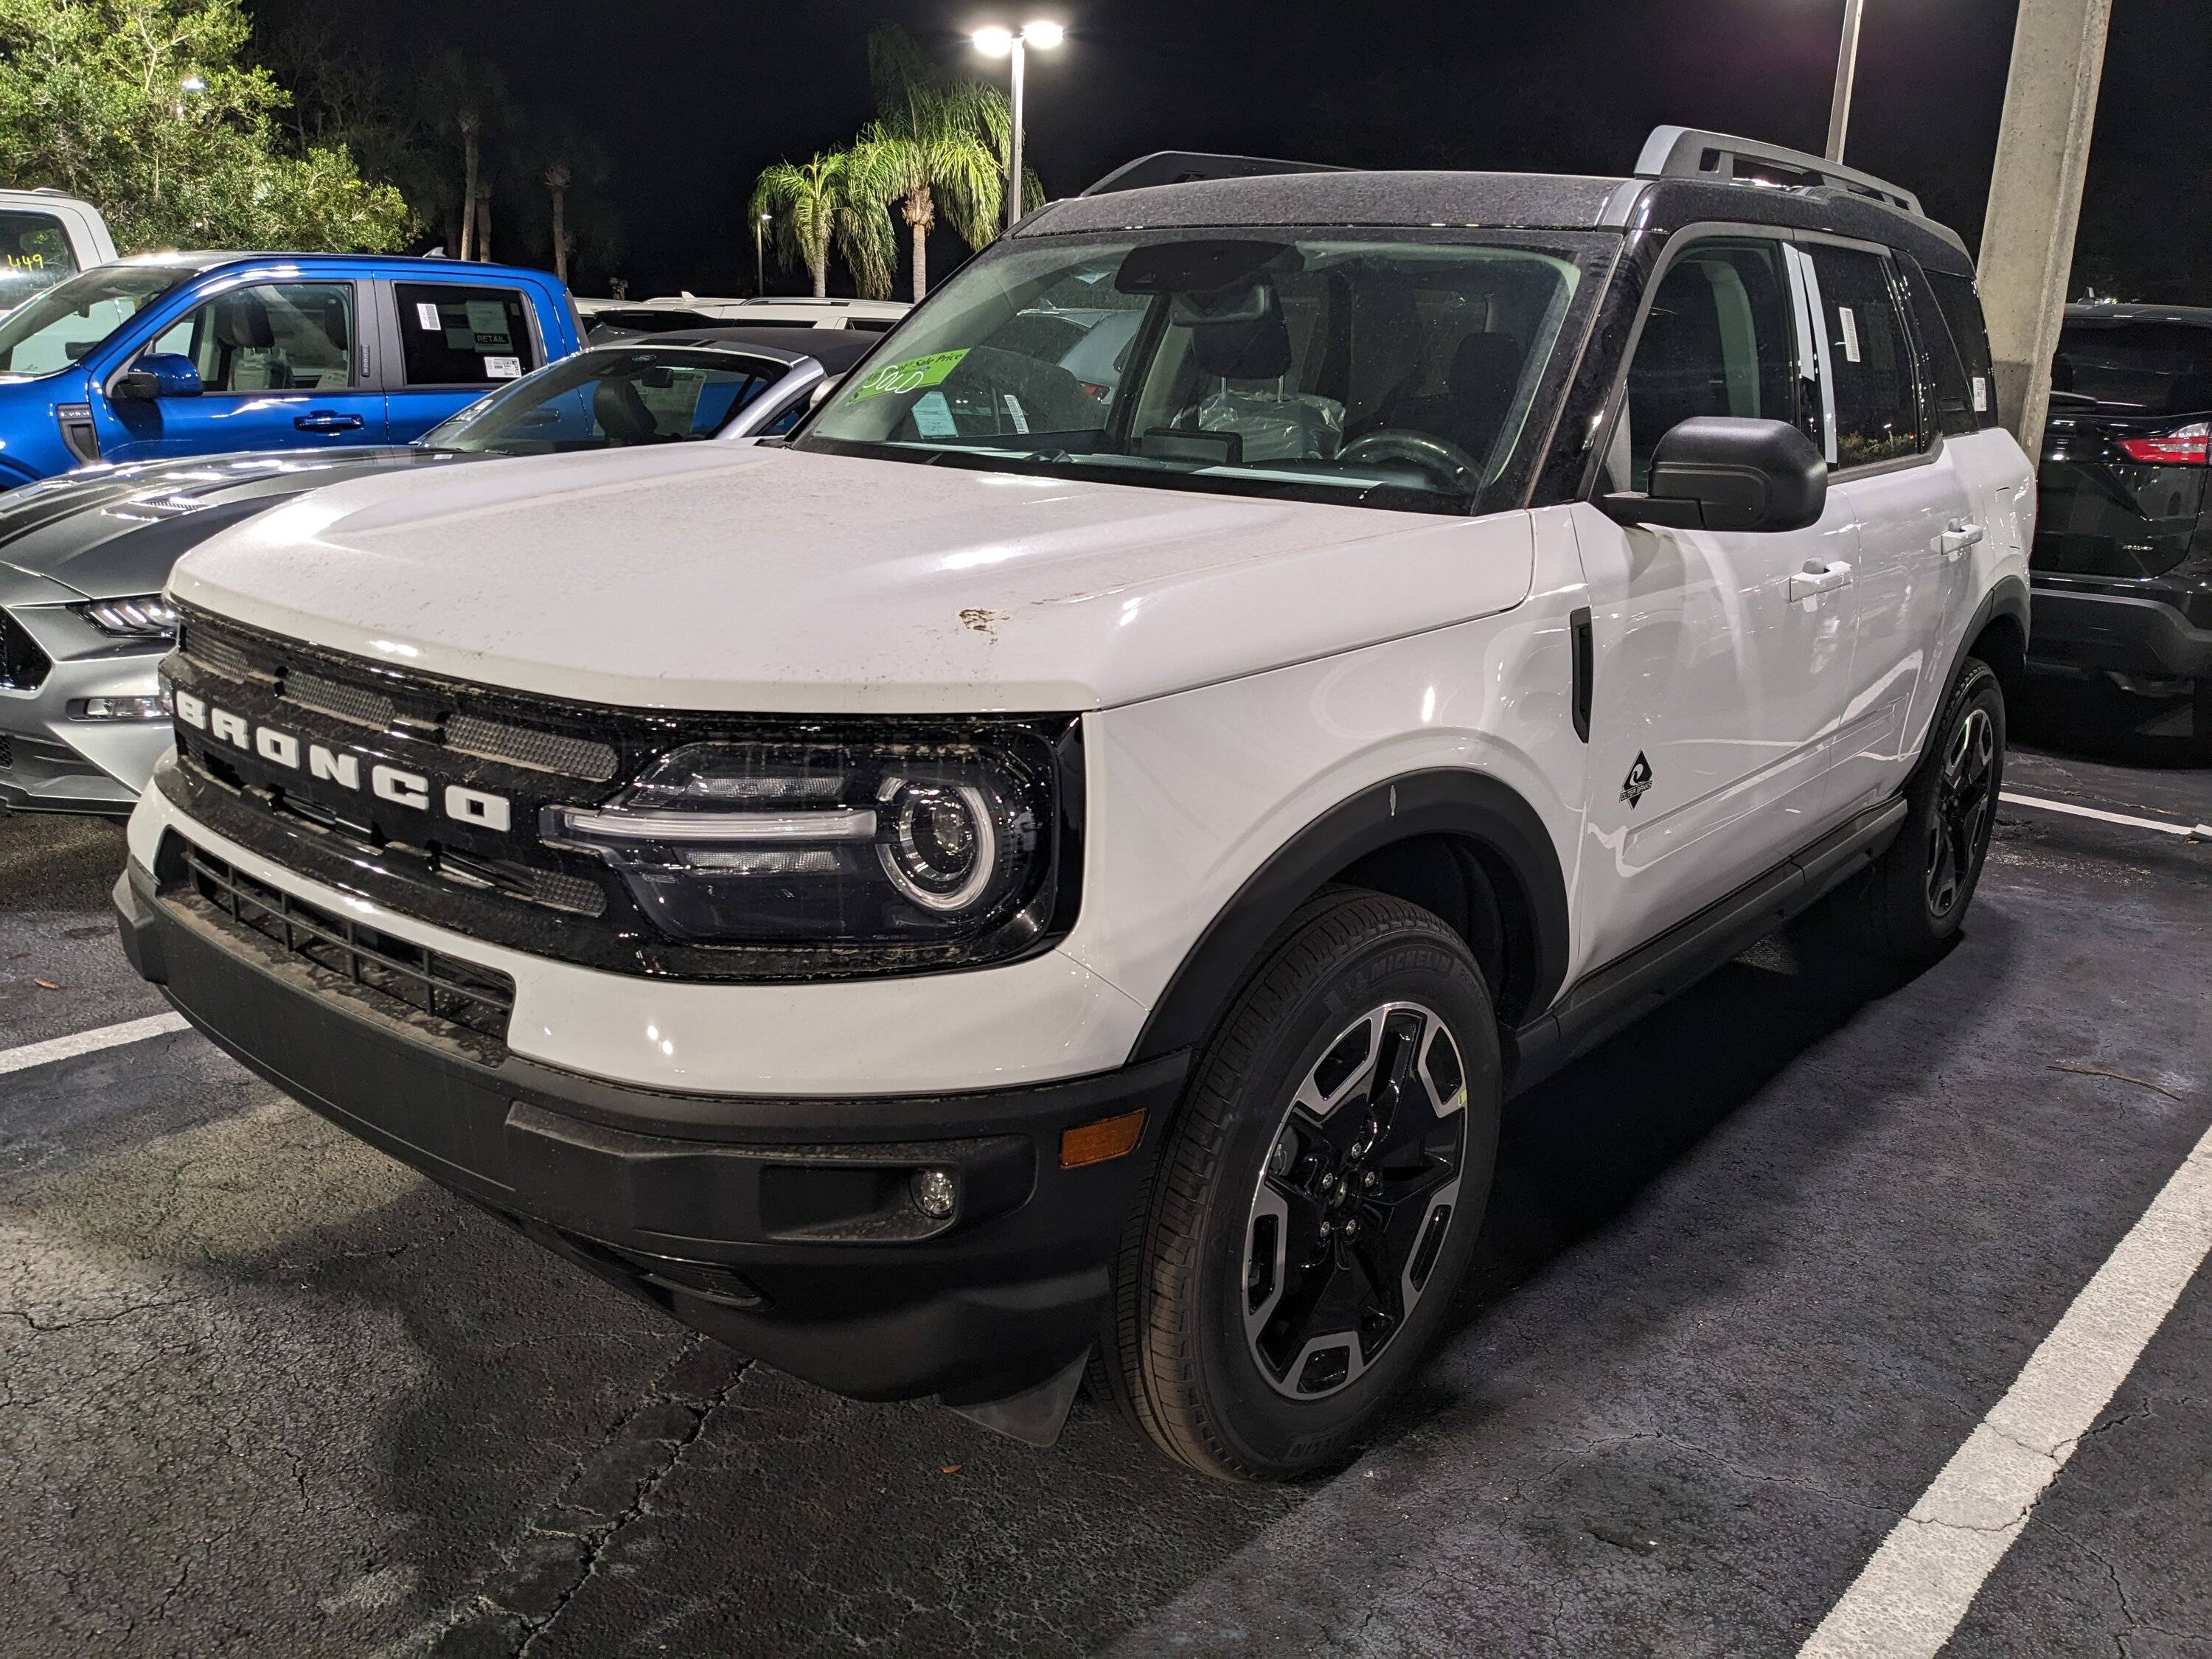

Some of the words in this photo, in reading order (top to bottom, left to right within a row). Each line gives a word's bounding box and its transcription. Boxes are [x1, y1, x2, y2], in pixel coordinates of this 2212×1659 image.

[7, 254, 43, 273] 449
[477, 335, 507, 343] RETAIL
[935, 353, 962, 364] Price
[863, 365, 924, 394] SOLD
[176, 690, 512, 832] BRONCO
[1621, 789, 1636, 800] OUTER
[1637, 782, 1652, 793] BANKS
[1371, 950, 1452, 983] MICHELIN
